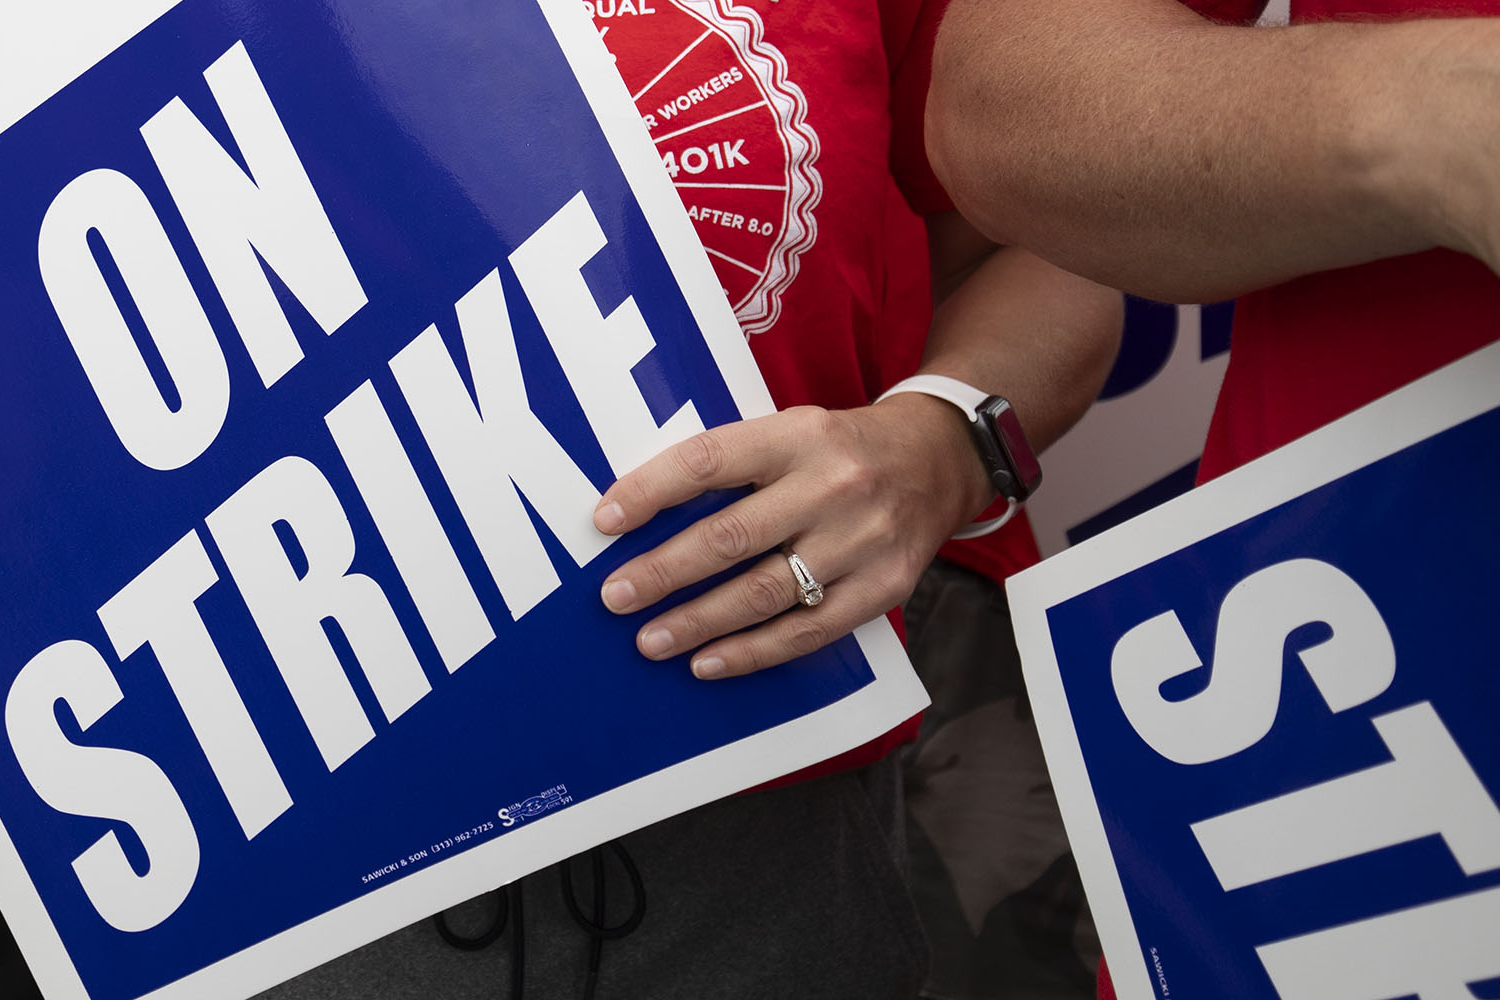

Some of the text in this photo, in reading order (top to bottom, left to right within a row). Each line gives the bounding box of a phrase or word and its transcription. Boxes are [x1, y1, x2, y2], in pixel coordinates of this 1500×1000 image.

[657, 66, 744, 120] WORKERS
[661, 139, 750, 178] 401K
[688, 205, 773, 236] AFTER 8.0
[37, 39, 369, 472] ON
[4, 189, 707, 934] STRIKE
[361, 821, 495, 884] SAWICKI & SON (313) 962-2725
